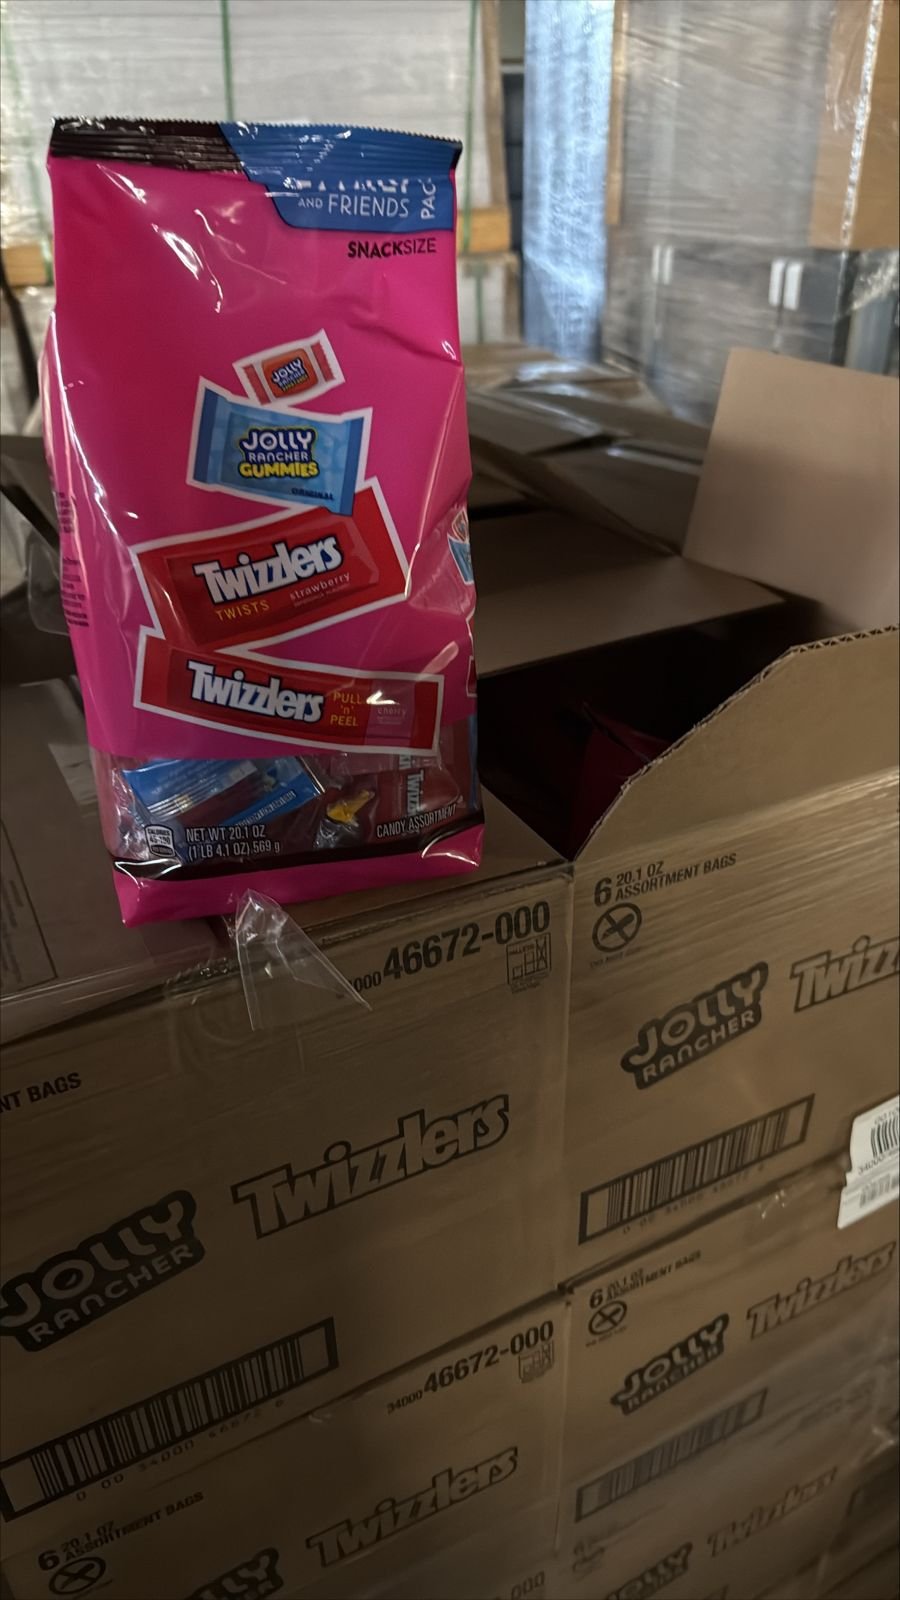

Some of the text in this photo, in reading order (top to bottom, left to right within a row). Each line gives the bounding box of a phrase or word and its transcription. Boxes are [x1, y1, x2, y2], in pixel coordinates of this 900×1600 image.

[298, 193, 410, 218] AND FRIENDS
[347, 238, 436, 258] SNACKSIZE
[271, 357, 304, 383] JOLLY
[242, 430, 313, 451] JOLLY
[239, 462, 318, 478] GUMMIES
[248, 451, 309, 463] RANCHER
[193, 535, 343, 605] Twizzlers
[289, 571, 351, 602] strawberry
[215, 600, 270, 623] TWISTS
[187, 659, 324, 724] Twizzlers
[332, 690, 363, 706] PULL
[330, 714, 359, 727] PEEL
[186, 825, 266, 842] NET WT 20.1 OZ
[376, 803, 456, 838] CANDY ASSORTMENT
[188, 845, 197, 862] (1
[201, 844, 213, 858] LB
[216, 843, 230, 857] 4.1
[233, 842, 250, 856] OZ)
[253, 840, 272, 853] 569
[274, 841, 280, 854] g
[615, 853, 737, 901] ASSORTMENT BAGS
[616, 860, 664, 887] 20.1 OZ
[594, 876, 612, 908] 6
[627, 968, 763, 1068] JOLLY
[642, 1008, 756, 1083] RANCHER
[26, 1072, 82, 1103] BAGS
[230, 1094, 509, 1240] Twizzlers
[0, 1198, 187, 1329] JOLLY
[27, 1243, 194, 1343] RANCHER
[589, 1288, 603, 1309] 6
[616, 1318, 725, 1402] JOLLY
[305, 1446, 518, 1568] Twizzlers
[38, 1550, 60, 1571] 6
